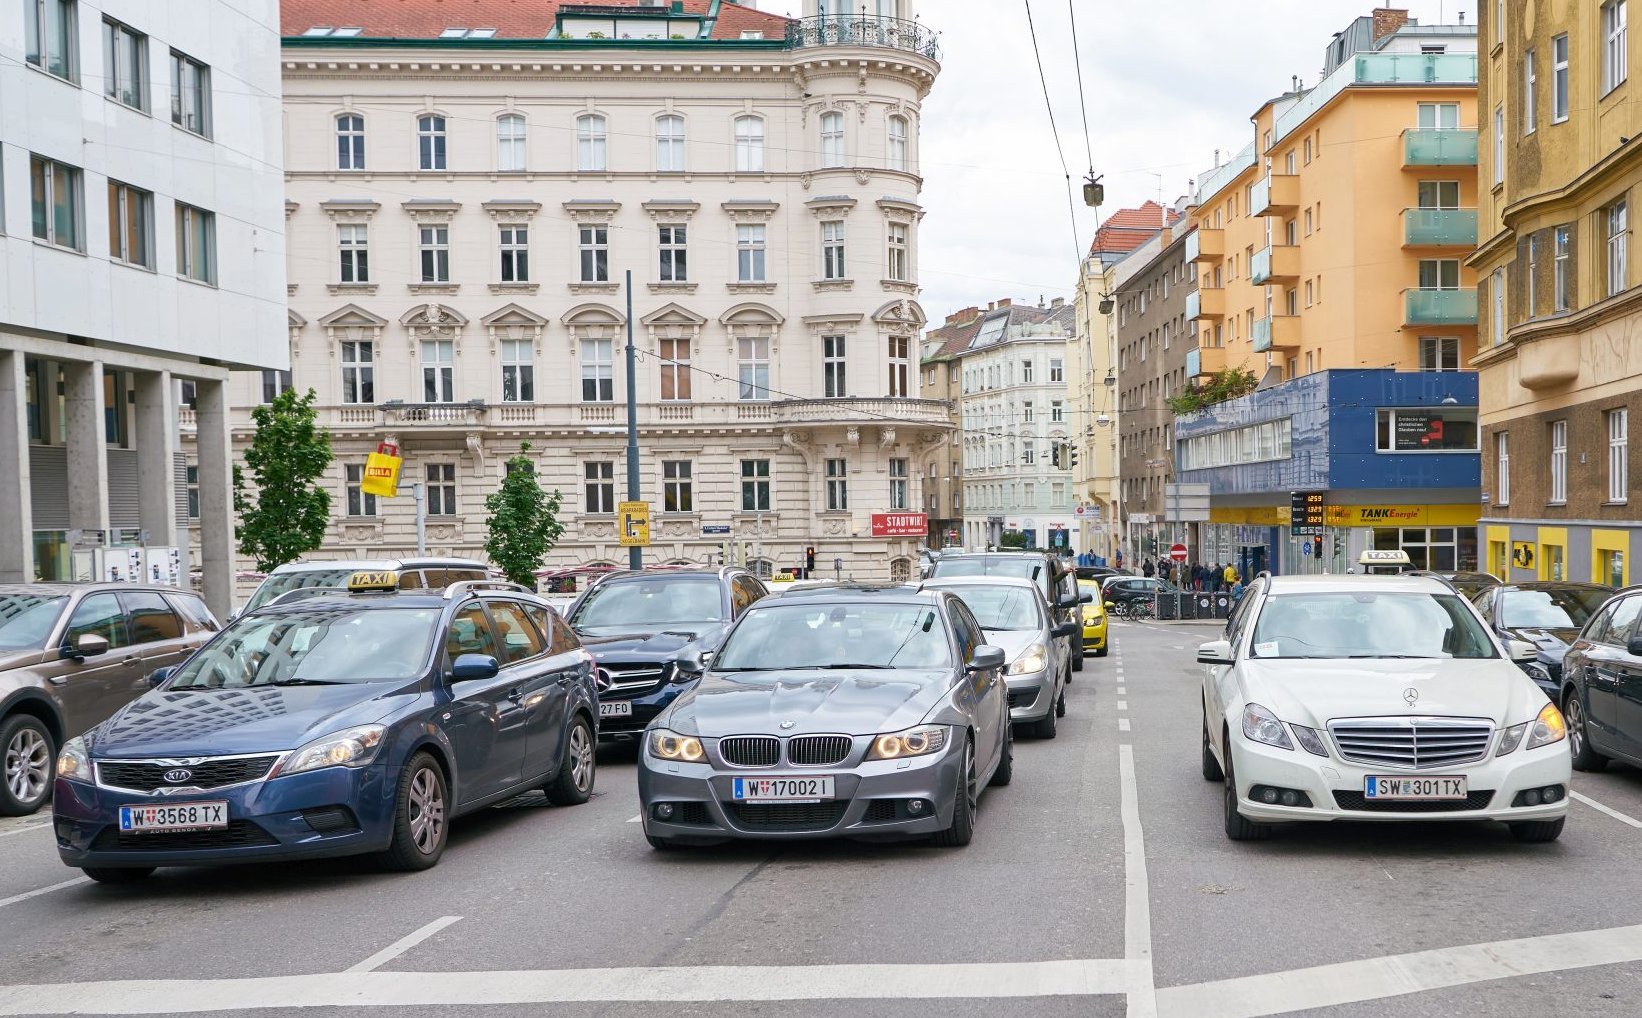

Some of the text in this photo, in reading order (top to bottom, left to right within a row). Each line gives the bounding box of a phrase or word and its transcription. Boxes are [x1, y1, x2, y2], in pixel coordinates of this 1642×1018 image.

[368, 468, 391, 477] BILLA
[886, 516, 923, 527] STADTWIRT
[1368, 552, 1402, 560] TAXI
[353, 572, 390, 585] TAXI
[600, 704, 613, 715] 27
[168, 771, 187, 779] KIA
[771, 780, 817, 796] 17002
[1379, 780, 1401, 795] SW
[157, 806, 198, 825] 3568
[202, 805, 221, 822] TX
